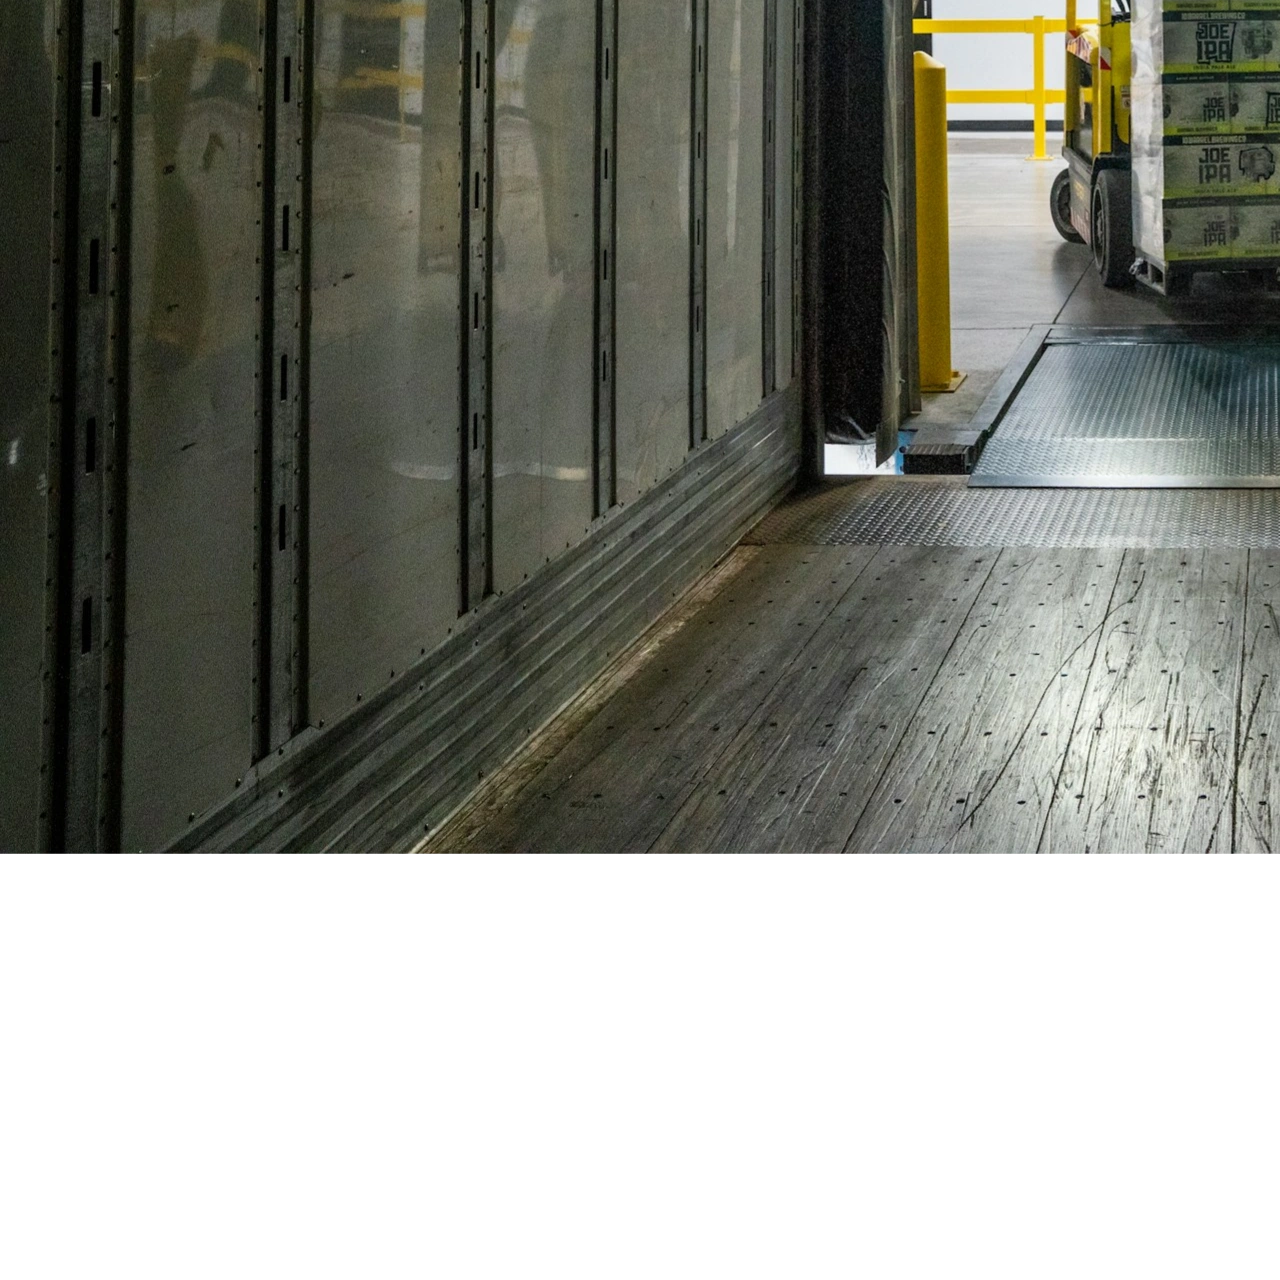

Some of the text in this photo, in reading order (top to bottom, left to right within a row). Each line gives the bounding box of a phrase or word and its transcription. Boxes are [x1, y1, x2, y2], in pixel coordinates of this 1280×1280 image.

[1199, 24, 1229, 39] JOE
[1197, 41, 1230, 60] IPA
[1203, 97, 1224, 108] JOE
[1203, 108, 1225, 122] IPA
[1199, 148, 1230, 163] JOE
[1199, 164, 1231, 184] IPA
[1204, 221, 1225, 232] JOE
[1204, 233, 1226, 247] IPA
